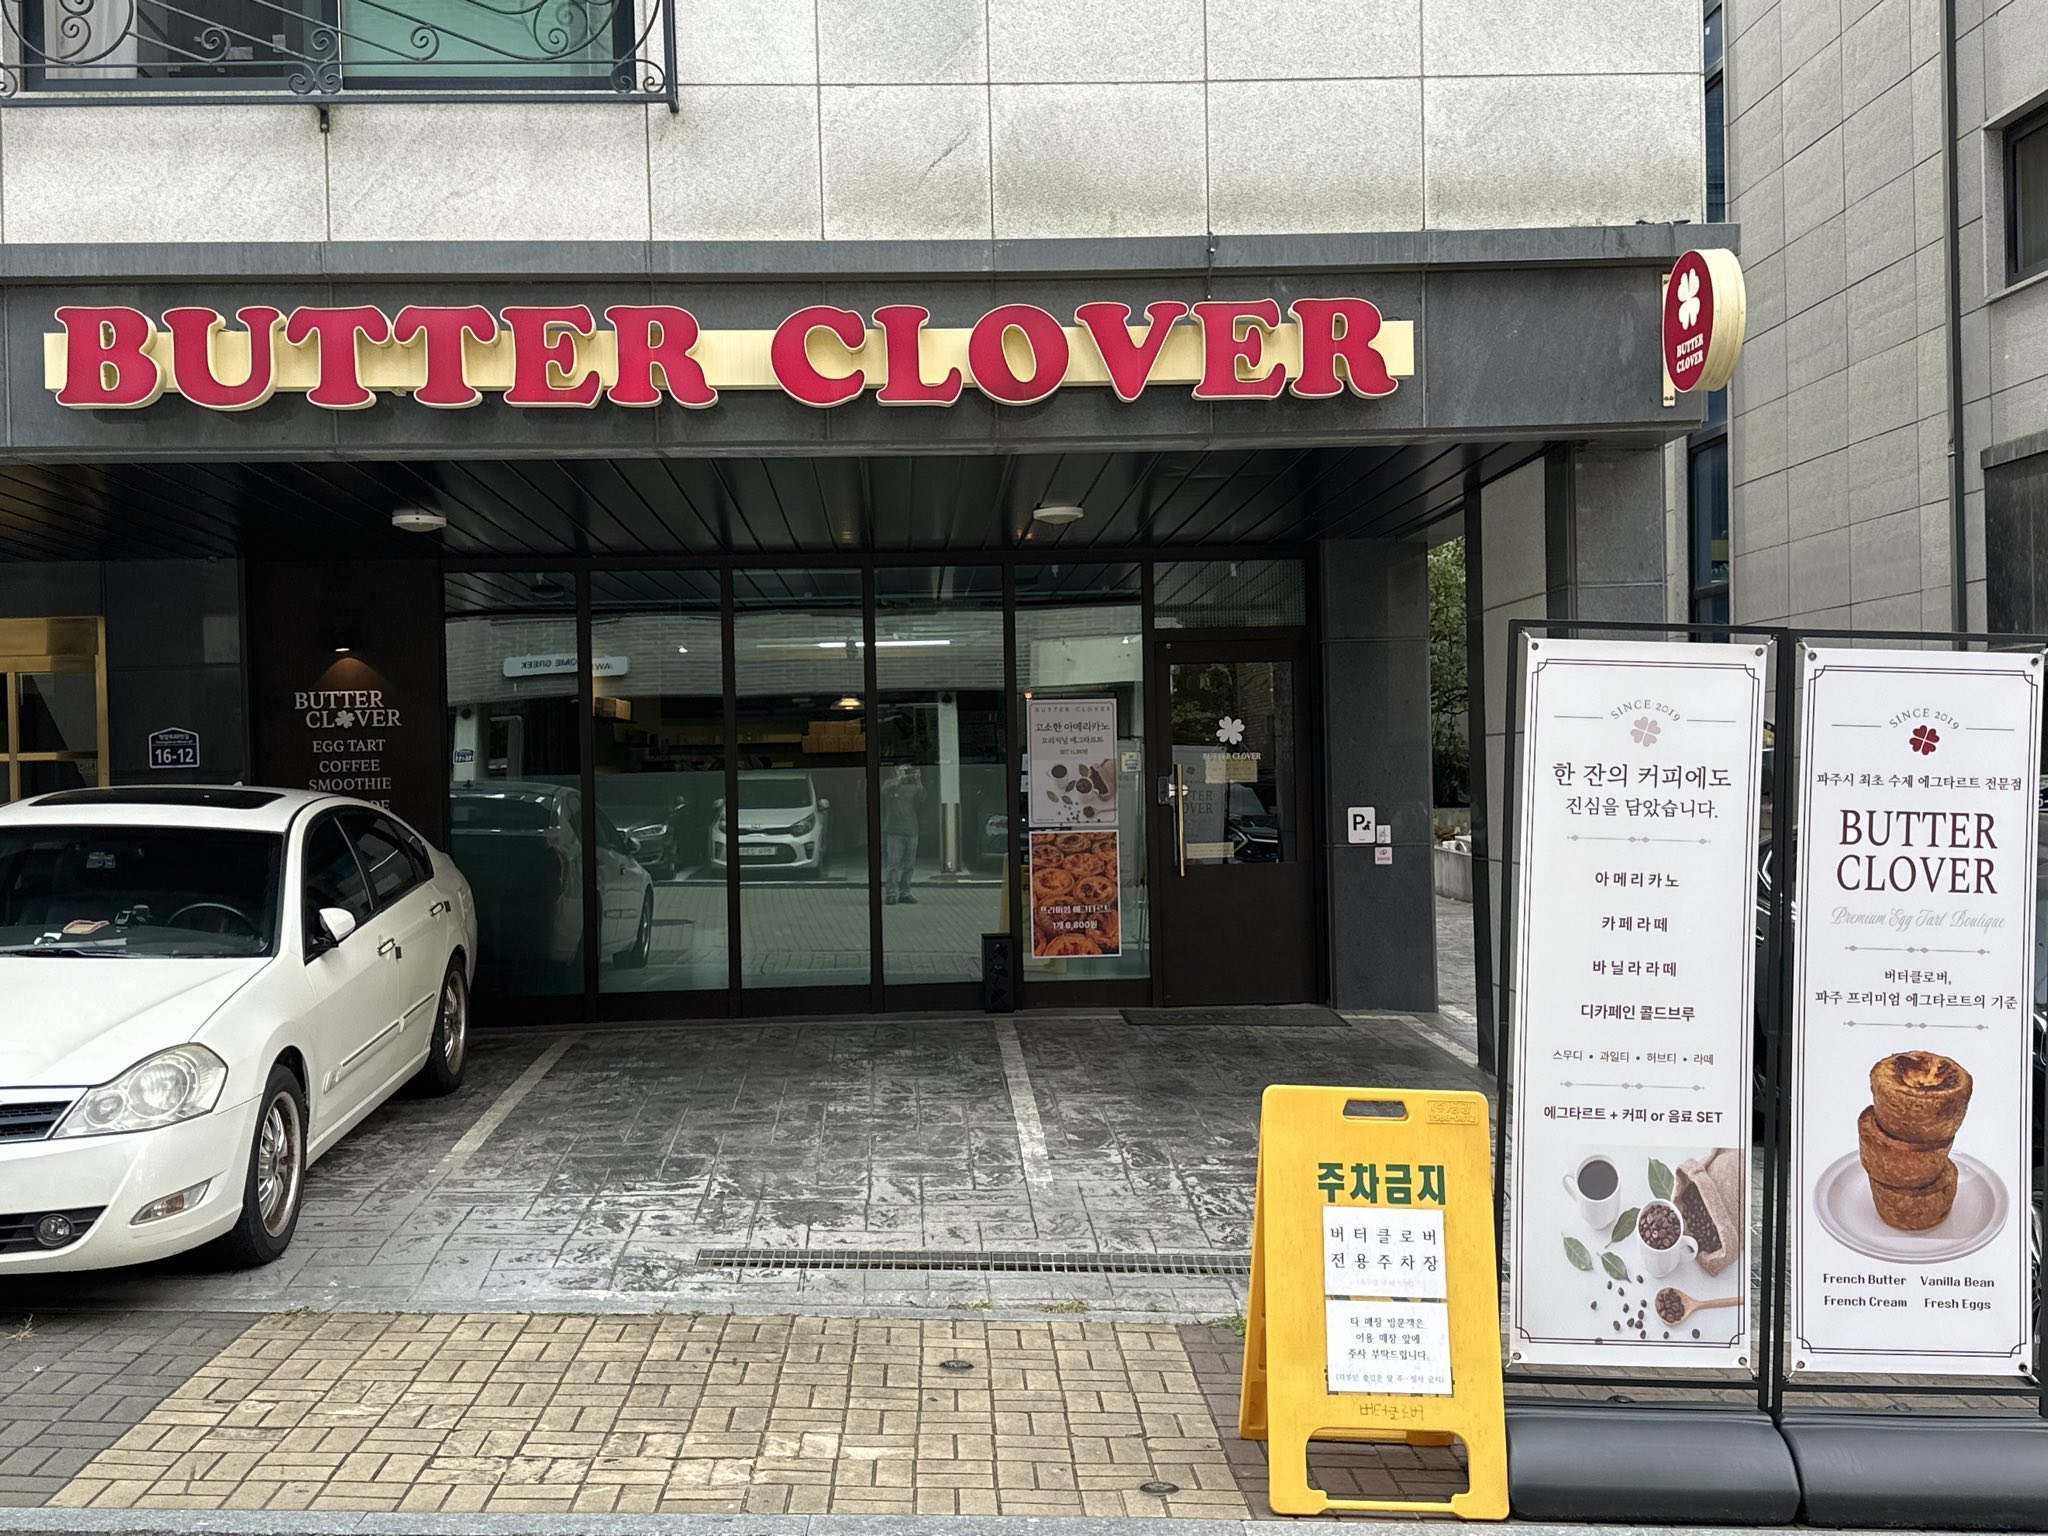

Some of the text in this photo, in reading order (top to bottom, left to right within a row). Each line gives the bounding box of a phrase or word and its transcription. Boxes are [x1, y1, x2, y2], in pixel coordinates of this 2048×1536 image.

[55, 297, 1399, 410] BUTTER CLOVER
[1676, 333, 1704, 358] BUTTER
[1676, 350, 1704, 374] CLOVER
[294, 690, 384, 709] BUTTER
[1610, 699, 1681, 723] SINCE 2019
[1889, 708, 1960, 731] SINCE 2019
[1034, 721, 1062, 733] 고소한
[312, 739, 386, 753] EGG TART
[155, 748, 194, 764] 16-12
[1203, 751, 1262, 761] BUTTER CLOVER
[319, 759, 381, 773] COFFEE
[308, 777, 392, 792] SMOOTHIE
[1552, 762, 1732, 790] 한 잔의 커피에도
[1816, 772, 2022, 792] 파주시 최초 수제 에그타르트 전문점
[1566, 796, 1719, 819] 진심을 담았습니다.
[1839, 809, 1999, 850] BUTTER
[1595, 871, 1680, 888] 아메리카노
[1836, 854, 1998, 895] CLOVER
[1601, 916, 1668, 933] 카페라떼
[1830, 905, 2006, 936] Premium Egg Tart Boutique
[1592, 960, 1677, 977] 바닐라라떼
[1884, 969, 1952, 986] 버터클로버,
[1815, 990, 2019, 1010] 파주 프리미엄 에그타르트의 기준
[1580, 1003, 1695, 1022] 디카페인 콜드브루
[1552, 1049, 1714, 1065] 스무디 과일티 허브티 라떼
[1543, 1105, 1606, 1121] 에그타르트
[1622, 1108, 1647, 1123] 커피
[1650, 1112, 1664, 1122] or
[1668, 1109, 1693, 1124] 음료
[1696, 1111, 1723, 1124] SET
[1317, 1162, 1446, 1206] 주차금지
[1823, 1273, 1995, 1289] French Butter Vanilla Bean
[1824, 1295, 1992, 1312] French Cream Fresh Eggs
[1364, 1316, 1382, 1328] 매장
[1355, 1332, 1374, 1344] 이용
[1378, 1333, 1397, 1345] 매장
